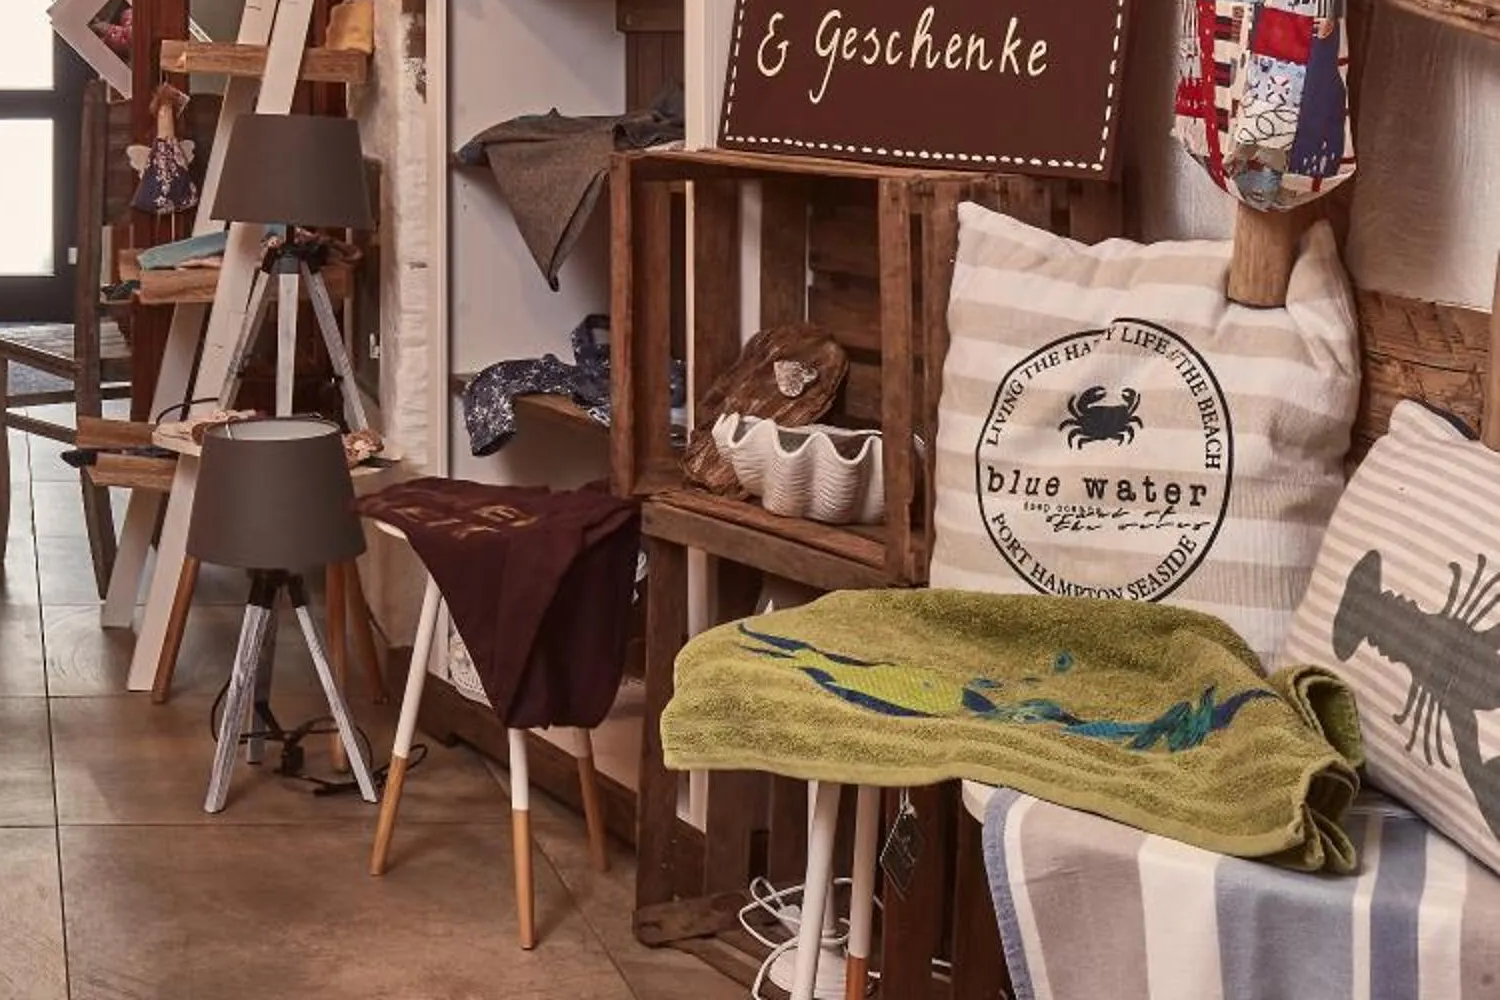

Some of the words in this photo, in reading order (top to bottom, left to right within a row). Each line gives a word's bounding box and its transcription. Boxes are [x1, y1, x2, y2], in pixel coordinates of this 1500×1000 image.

[756, 12, 790, 78] &
[808, 5, 1049, 104] Geschenke
[985, 378, 1025, 447] LIVING
[1019, 350, 1062, 380] THE
[1063, 326, 1117, 361] HAY
[1120, 326, 1171, 355] LIFE
[1175, 351, 1209, 397] THE
[1197, 395, 1222, 470] BEACH
[987, 465, 1061, 498] blue
[1081, 475, 1208, 508] water
[991, 512, 1033, 565] PORT
[1126, 533, 1198, 602] SEASIDE
